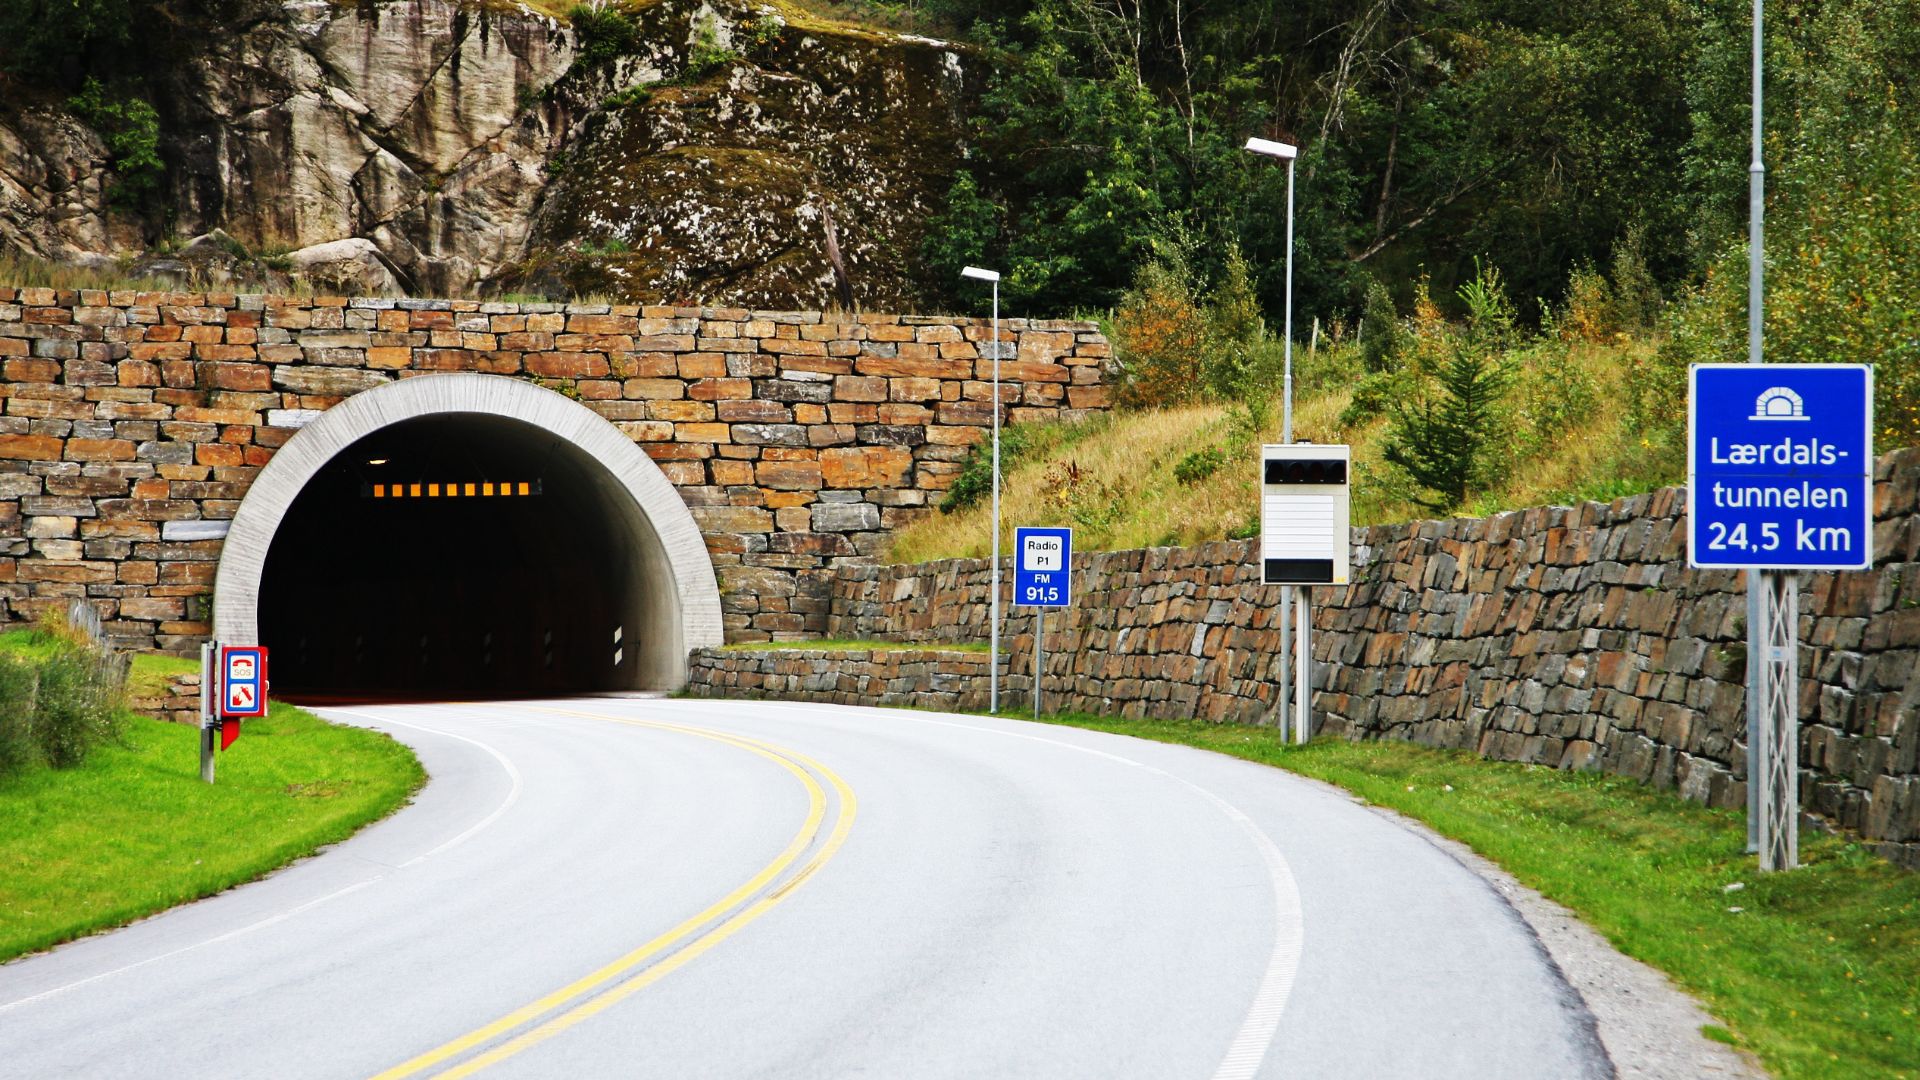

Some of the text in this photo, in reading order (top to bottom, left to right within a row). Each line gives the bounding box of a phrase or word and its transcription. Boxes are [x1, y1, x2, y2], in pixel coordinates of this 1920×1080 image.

[1711, 437, 1848, 465] Lærdals-
[1713, 481, 1848, 508] tunnelen
[1708, 519, 1851, 553] 24,5 km
[1028, 541, 1058, 550] Radio
[1037, 557, 1049, 565] P1
[1034, 574, 1050, 583] FM
[1026, 587, 1059, 603] 91,5
